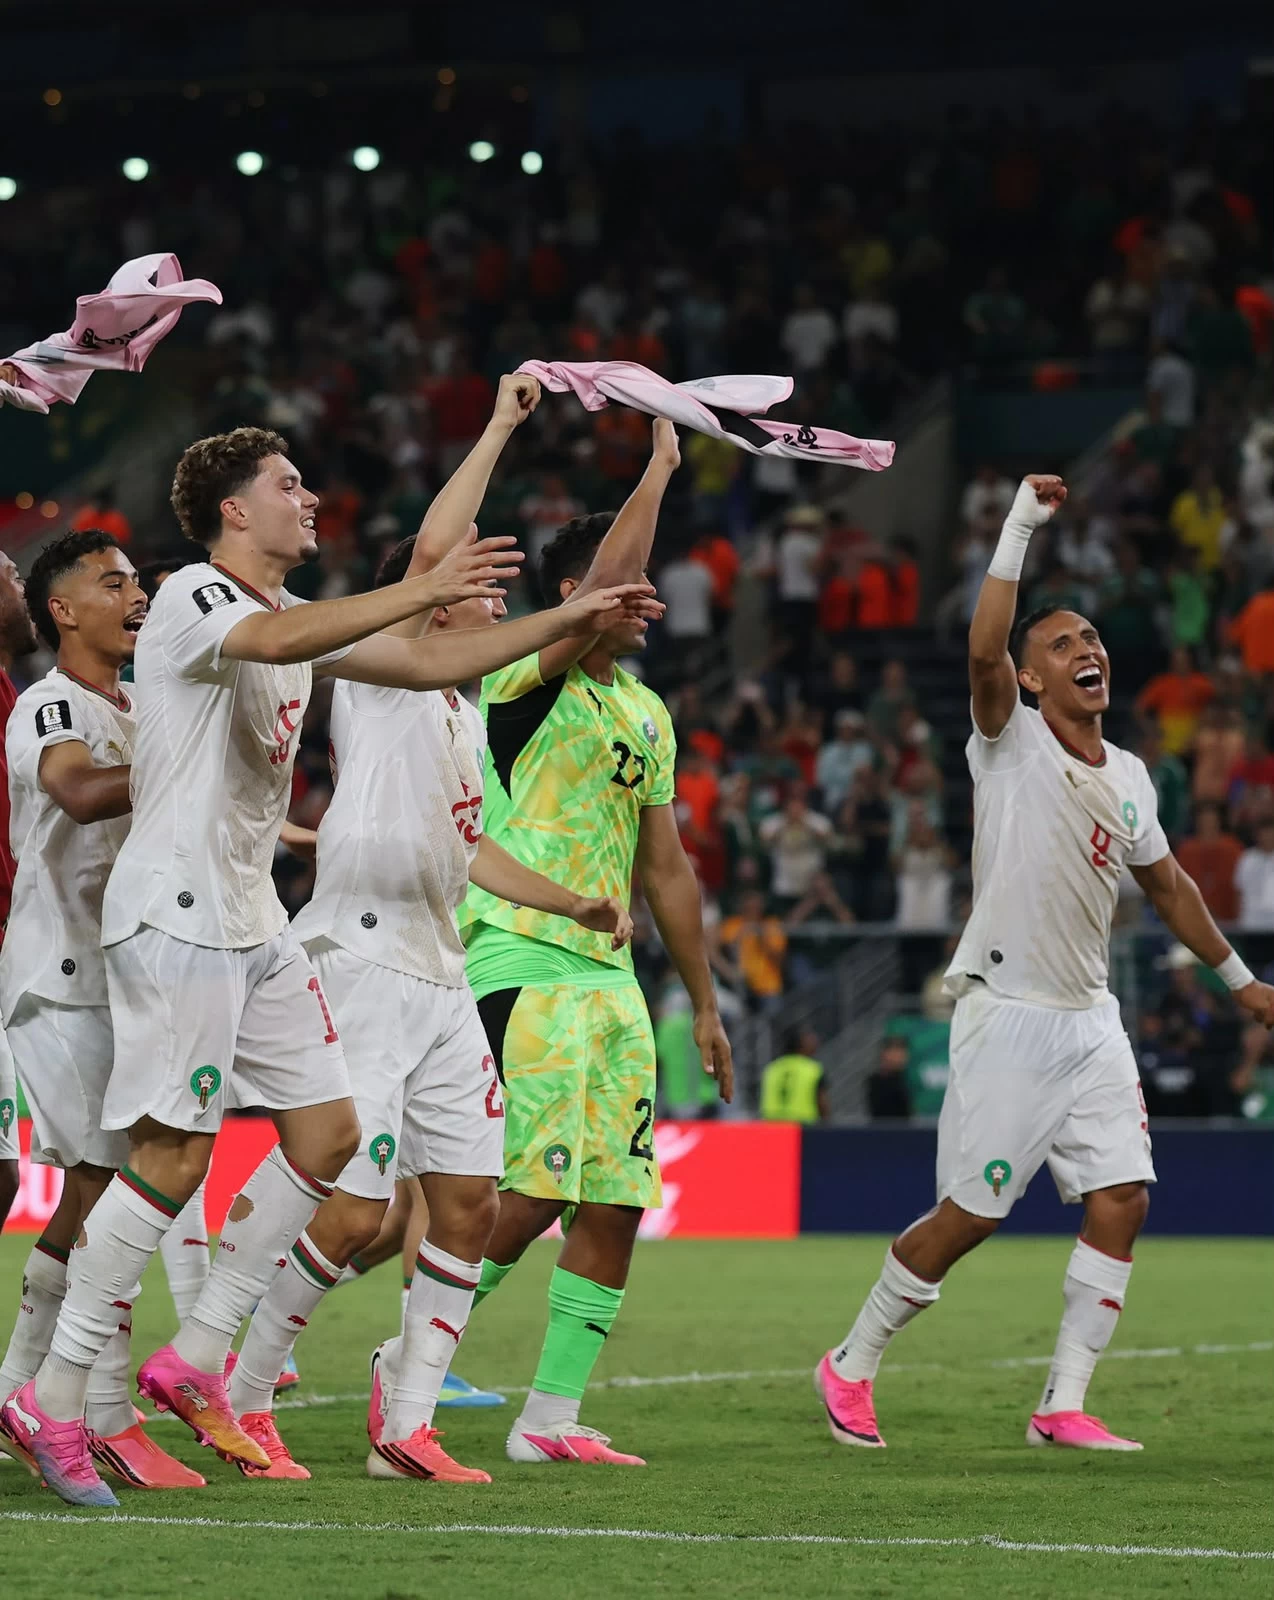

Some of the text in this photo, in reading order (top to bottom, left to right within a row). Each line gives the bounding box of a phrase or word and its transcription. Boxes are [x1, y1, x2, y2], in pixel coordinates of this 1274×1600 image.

[1090, 823, 1112, 867] 9
[481, 1054, 504, 1118] 2
[629, 1098, 653, 1161] 2
